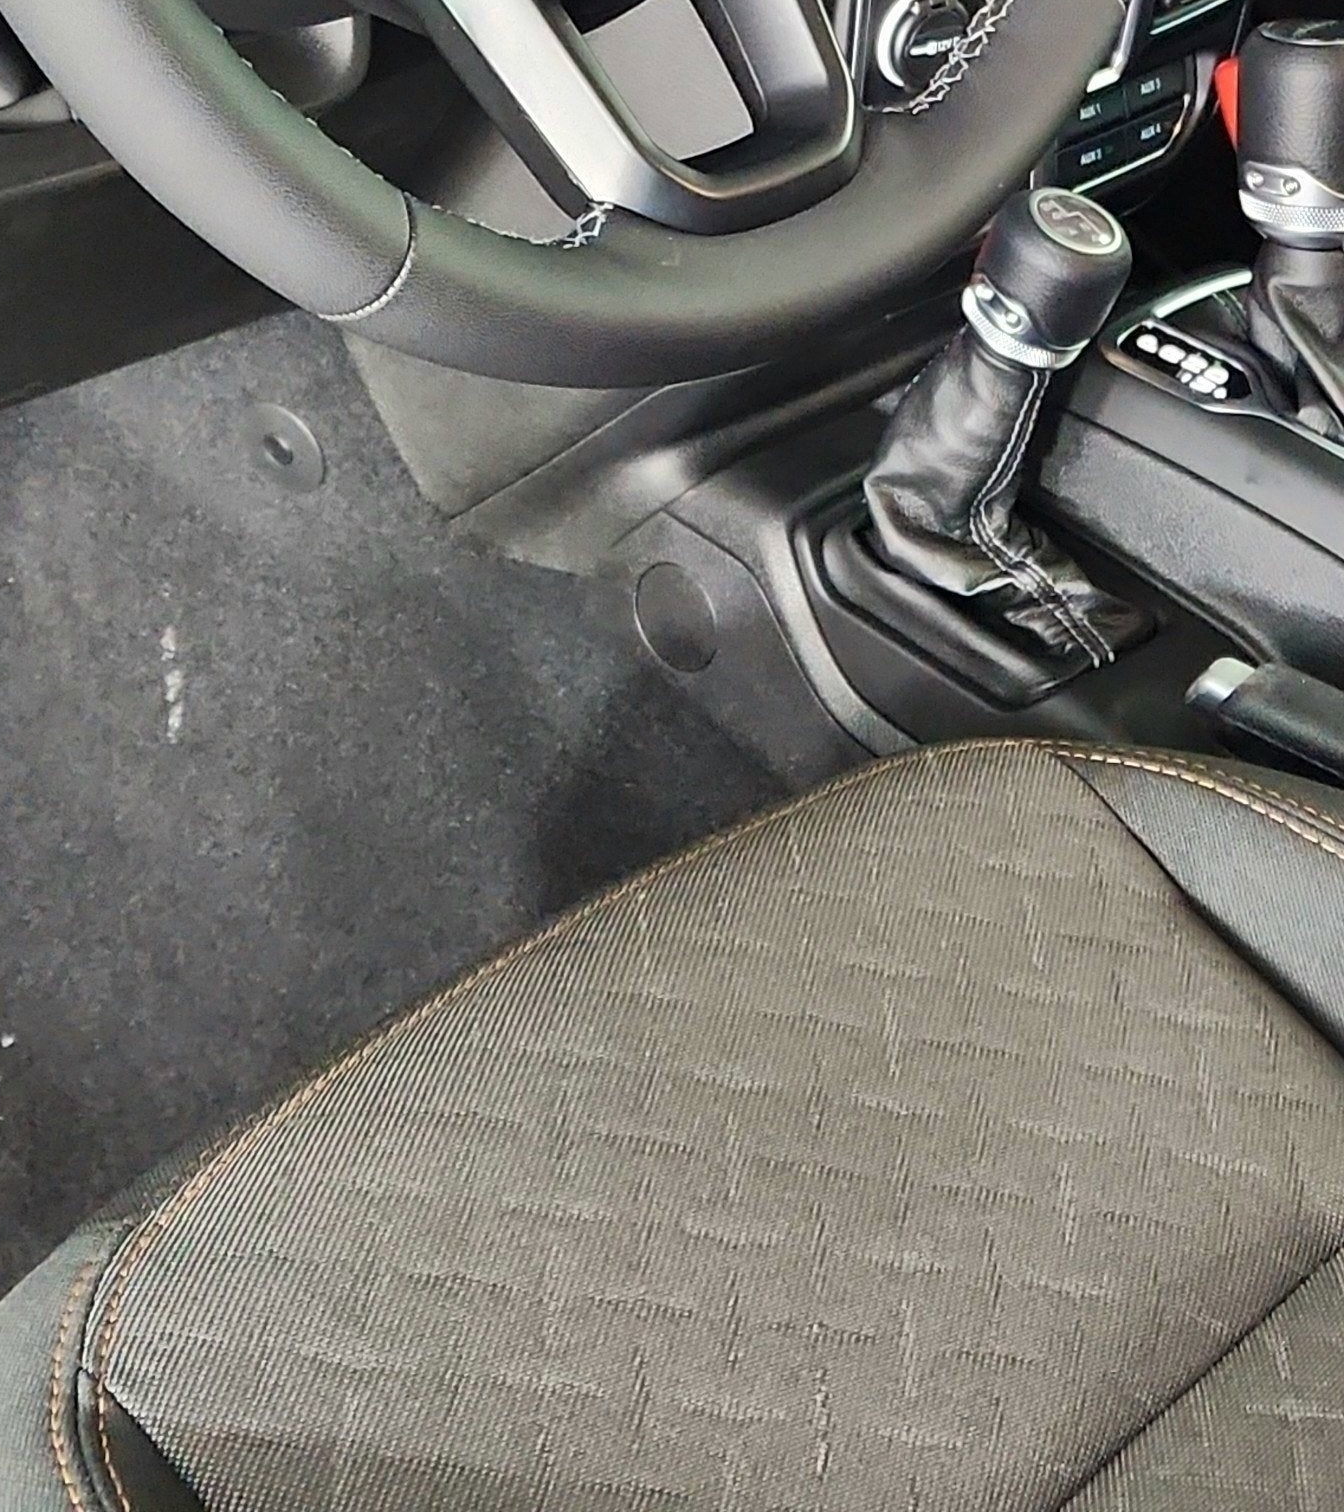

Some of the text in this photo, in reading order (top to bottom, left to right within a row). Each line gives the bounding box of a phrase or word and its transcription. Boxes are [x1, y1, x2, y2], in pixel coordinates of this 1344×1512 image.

[1141, 79, 1156, 95] AUX
[1080, 104, 1096, 121] AUX
[1140, 125, 1156, 140] AUX
[1080, 150, 1096, 166] AUX
